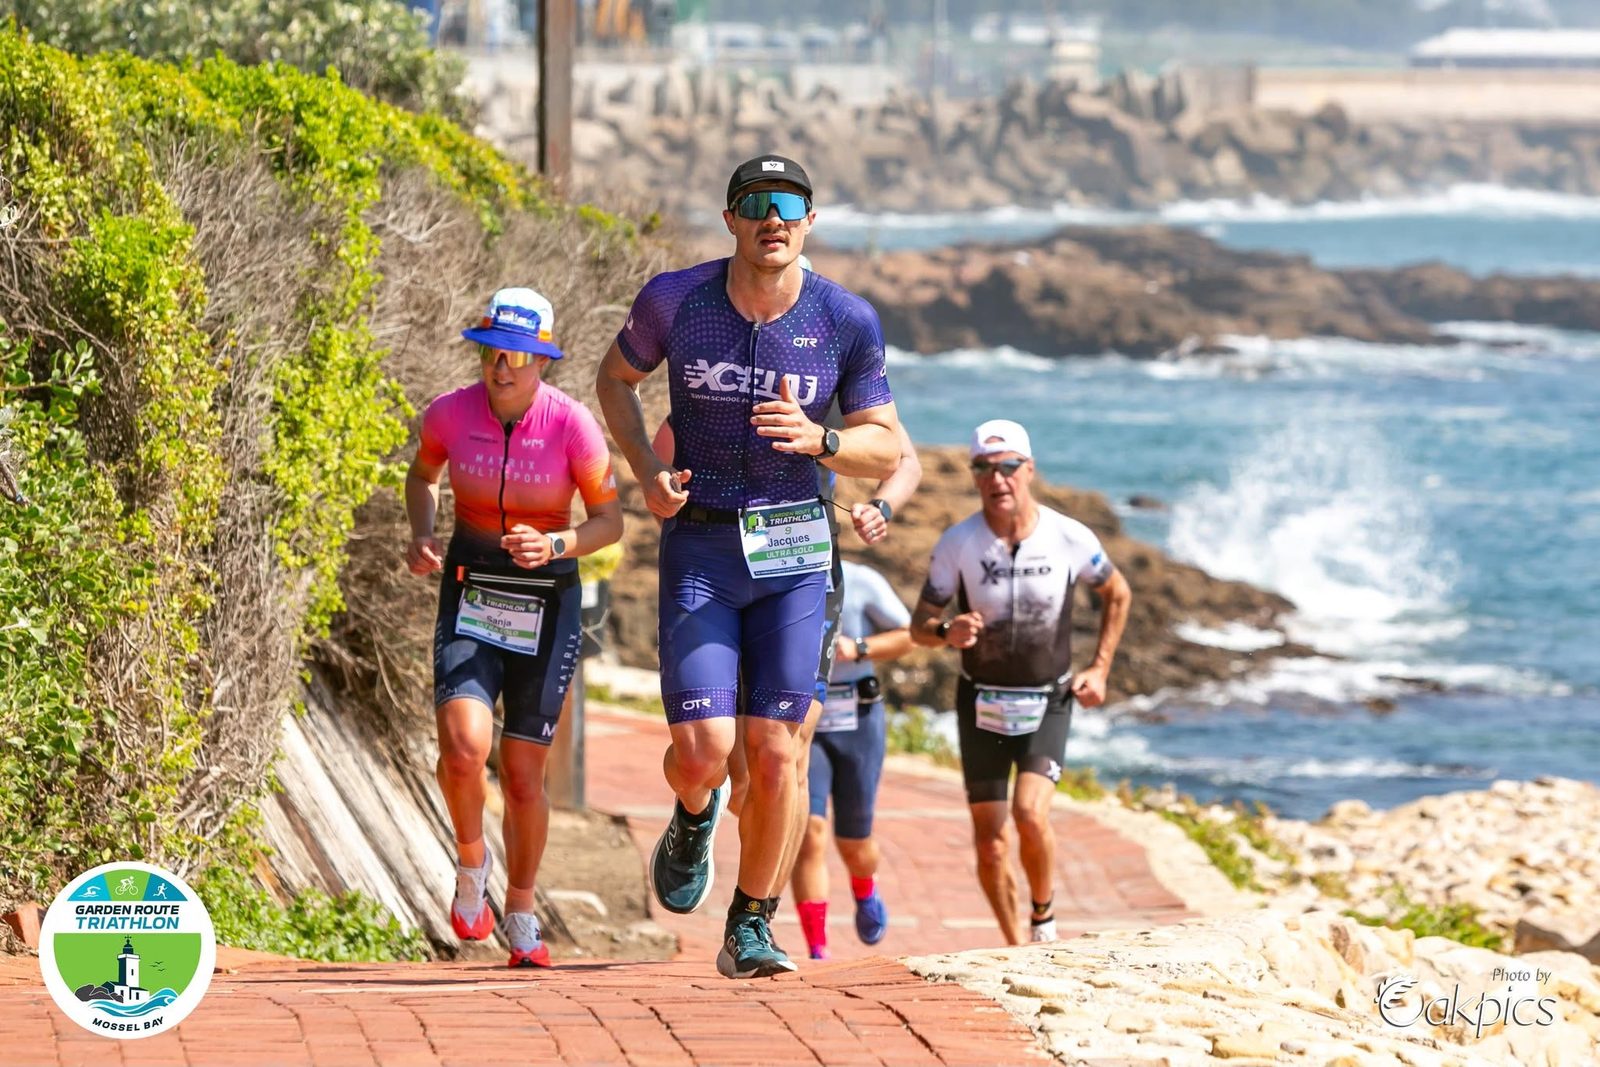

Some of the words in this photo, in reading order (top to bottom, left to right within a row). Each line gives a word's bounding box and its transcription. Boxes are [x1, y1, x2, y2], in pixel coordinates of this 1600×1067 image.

[711, 395, 740, 403] SCHOOL
[475, 454, 535, 470] MATRIX
[460, 462, 551, 483] MULTISPORT
[770, 513, 812, 525] TRIATHLON
[767, 534, 810, 548] Jacques
[766, 549, 792, 559] ULTRA
[792, 545, 814, 556] SOLO
[486, 600, 526, 612] TRIATHLON
[487, 615, 512, 628] Sanja
[557, 633, 578, 694] MATRIX
[682, 698, 711, 710] OTR
